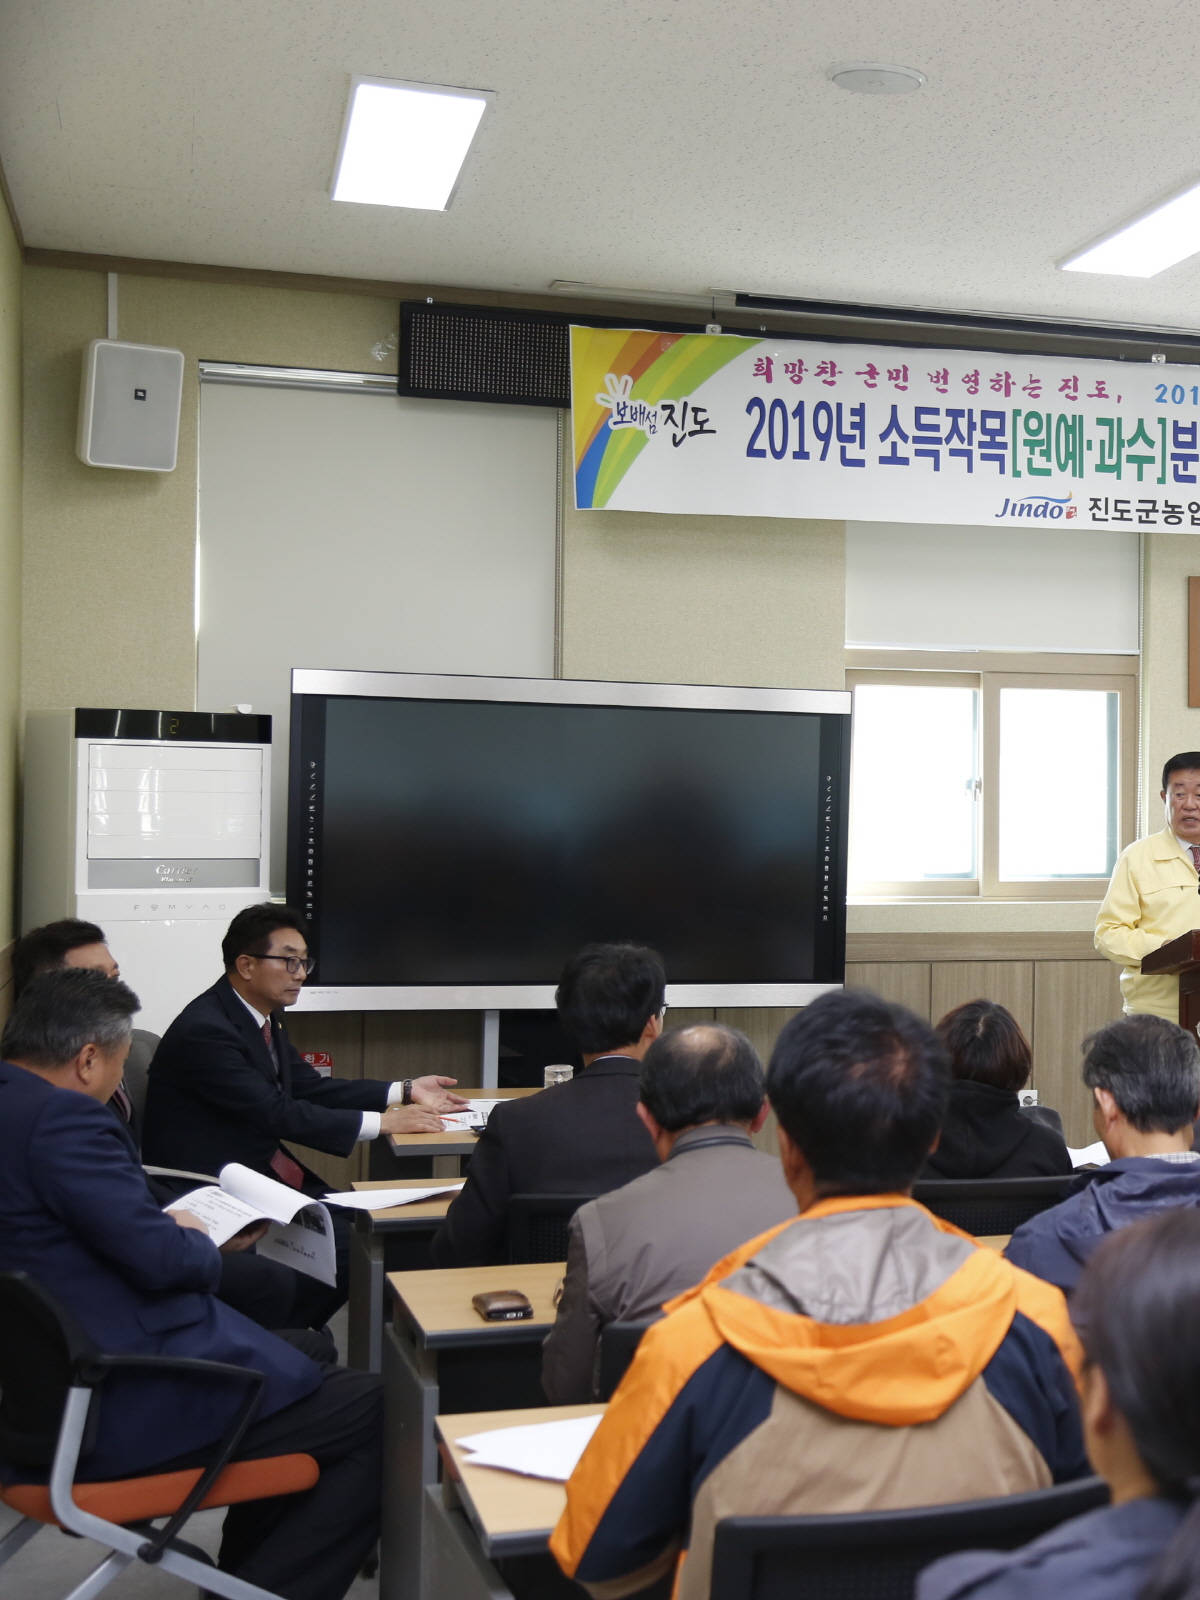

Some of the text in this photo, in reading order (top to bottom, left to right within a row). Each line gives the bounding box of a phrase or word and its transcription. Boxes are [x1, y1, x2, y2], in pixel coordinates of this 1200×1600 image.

[752, 356, 1123, 404] 희망찬 군민 번영하는 진도,
[613, 401, 717, 448] 보배섬 진도
[745, 396, 866, 468] 2019년
[995, 496, 1064, 520] Jindo
[156, 864, 198, 875] Carrier
